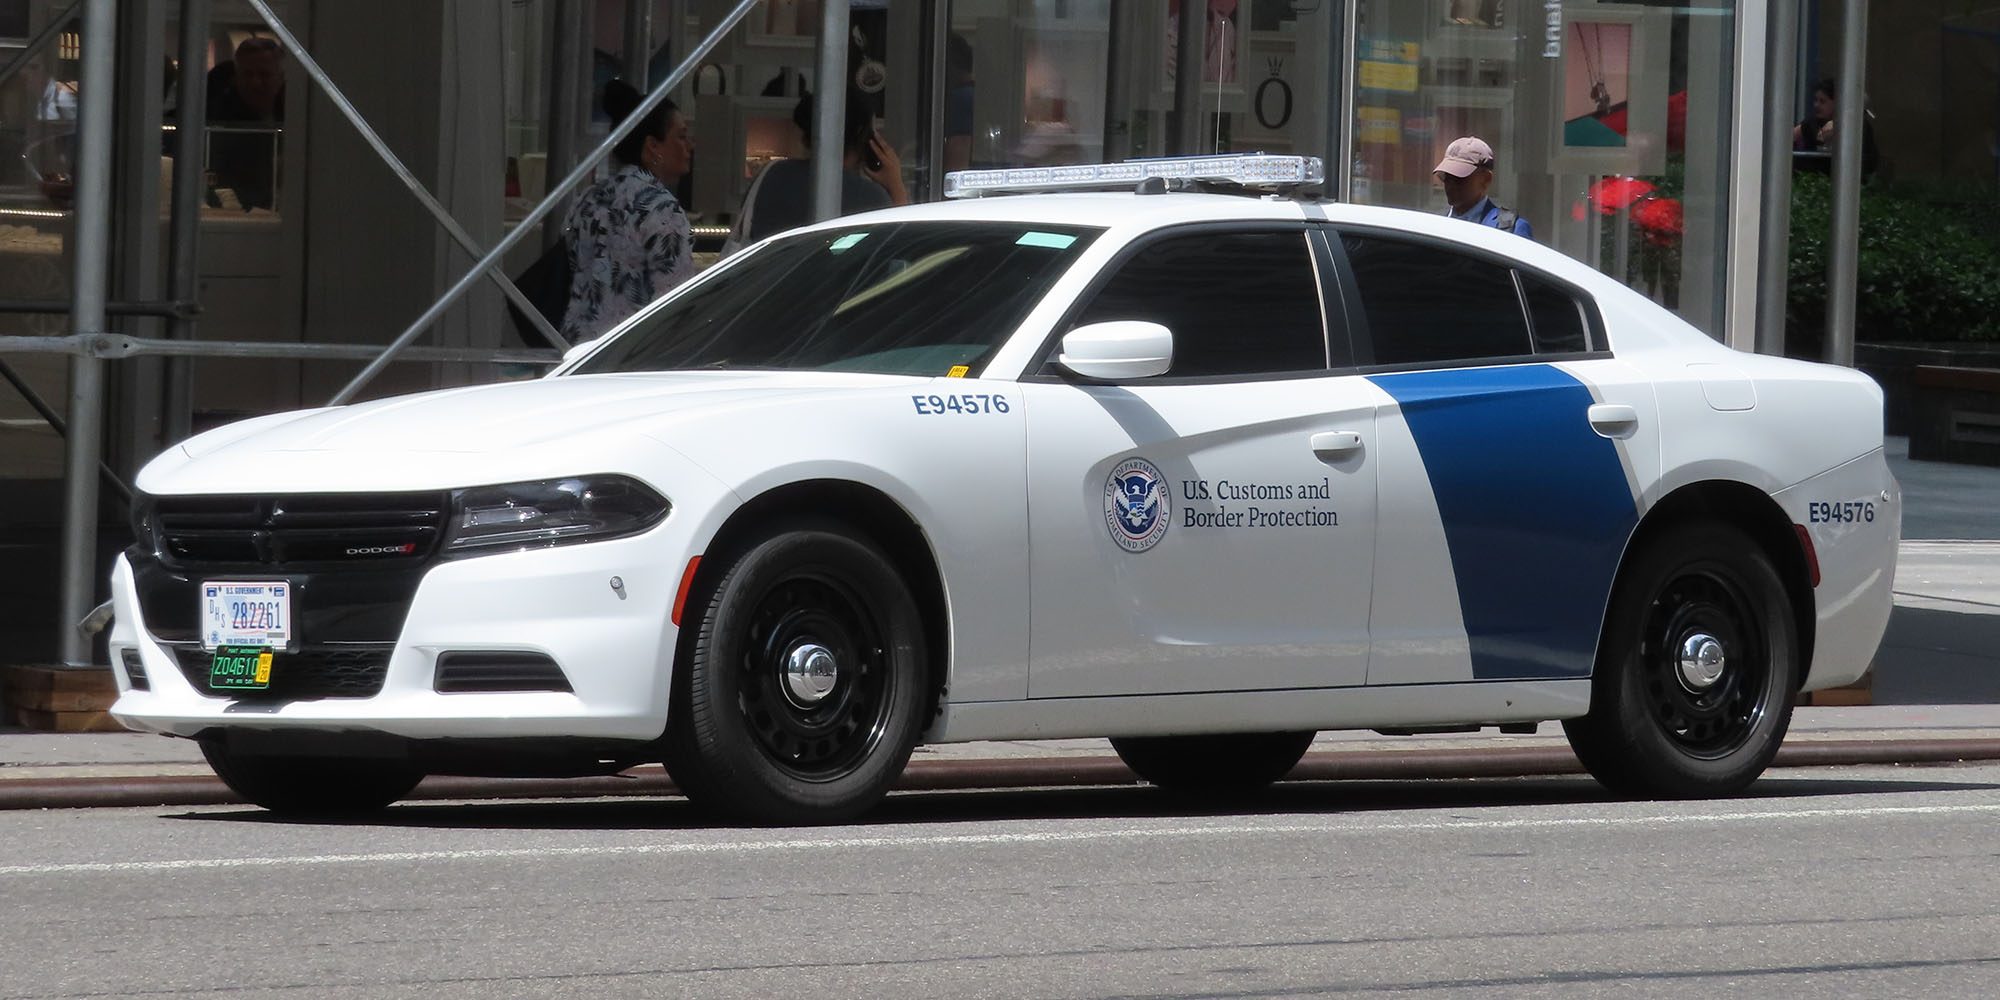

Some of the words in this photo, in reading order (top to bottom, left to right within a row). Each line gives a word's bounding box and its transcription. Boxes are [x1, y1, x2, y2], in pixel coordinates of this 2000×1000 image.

[912, 394, 1010, 415] E94576
[1115, 462, 1162, 484] DEPARTMENT
[1160, 486, 1169, 497] OF
[1182, 479, 1212, 500] U.S.
[1217, 480, 1293, 500] Customs
[1298, 477, 1330, 500] and
[1183, 505, 1244, 527] Border
[1248, 506, 1338, 527] Protection
[1809, 502, 1874, 523] E94576
[1107, 509, 1138, 549] HOMELAND
[1140, 511, 1168, 549] SECURITY
[346, 545, 407, 554] DODGE
[232, 602, 281, 629] 282261
